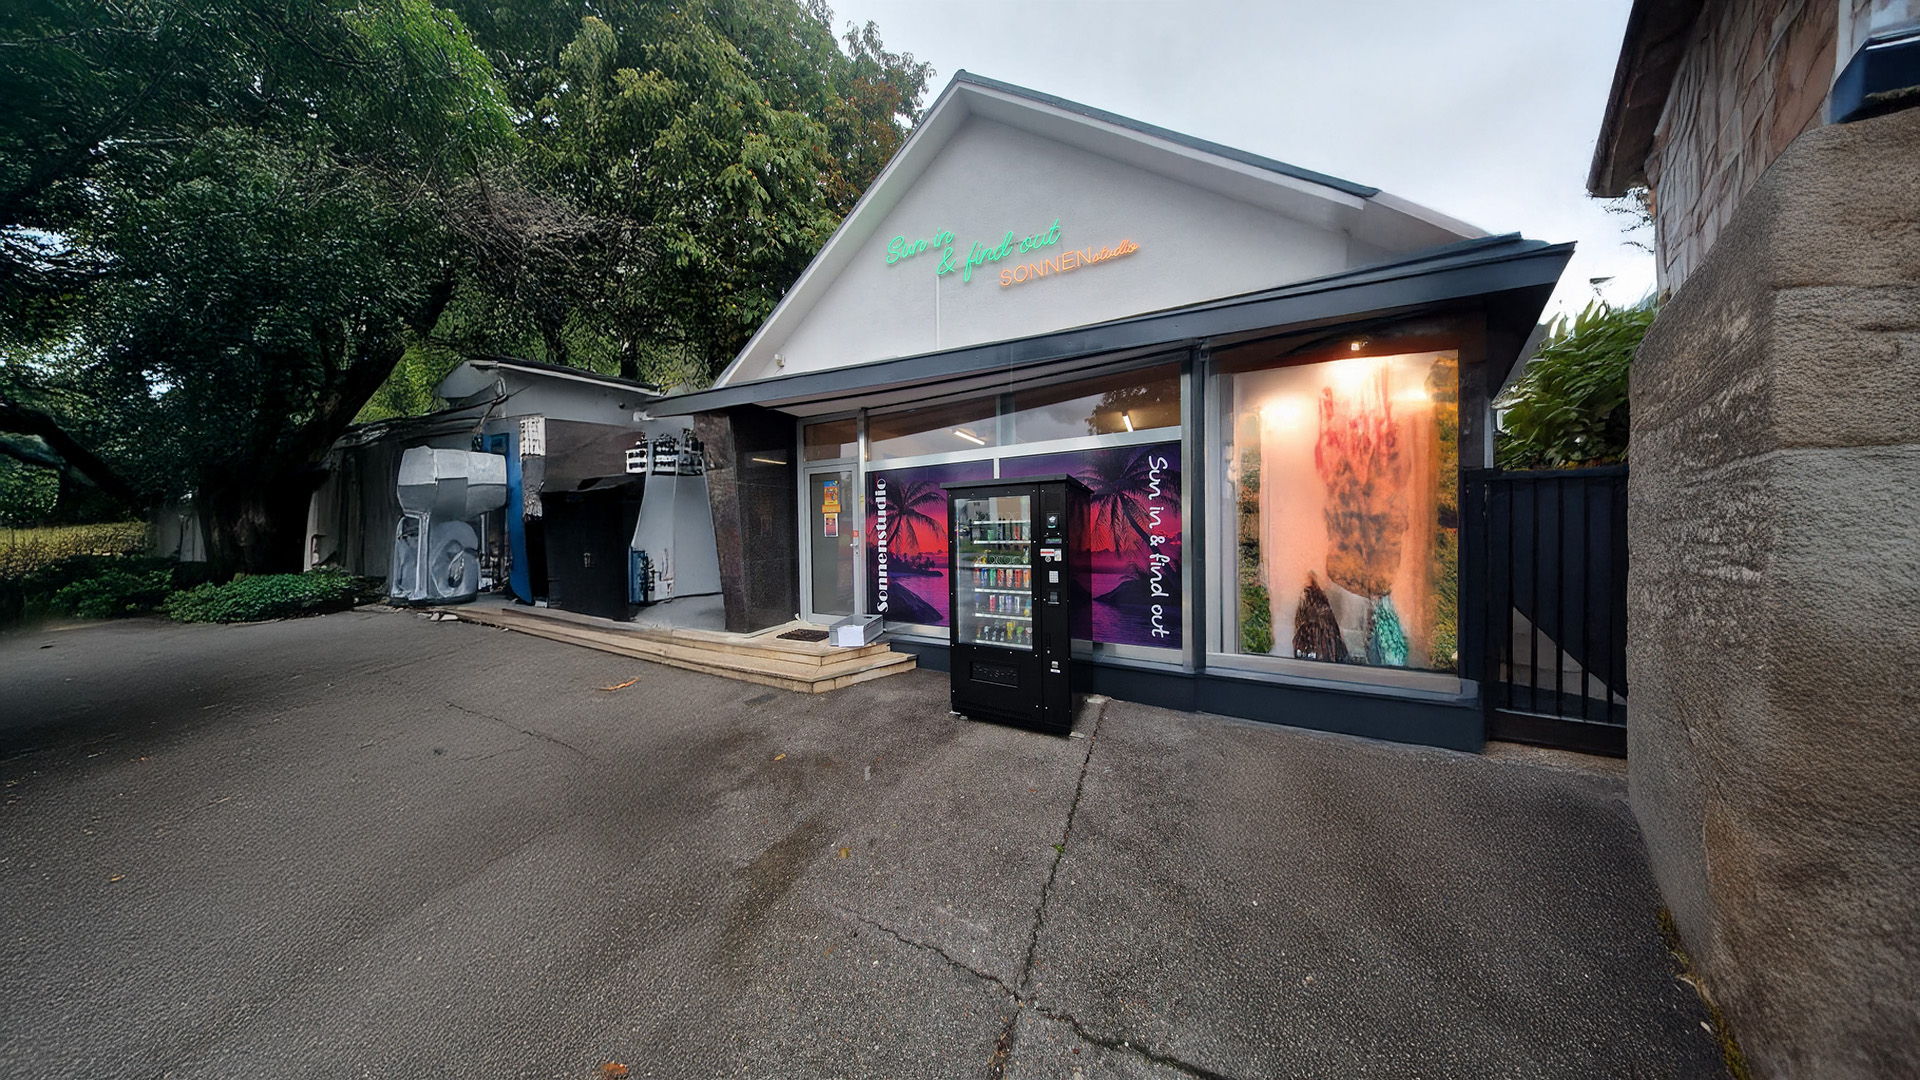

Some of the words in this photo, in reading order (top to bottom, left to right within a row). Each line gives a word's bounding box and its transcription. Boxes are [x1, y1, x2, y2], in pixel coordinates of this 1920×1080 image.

[886, 234, 929, 265] Sun
[932, 227, 955, 249] in
[936, 246, 957, 276] &
[963, 230, 1014, 283] find
[1018, 218, 1061, 254] out
[1148, 455, 1168, 501] Sun
[1149, 506, 1165, 529] in
[874, 478, 888, 613] Sonnenstudio
[1150, 534, 1166, 547] &
[1149, 553, 1170, 597] find
[1150, 604, 1170, 638] out
